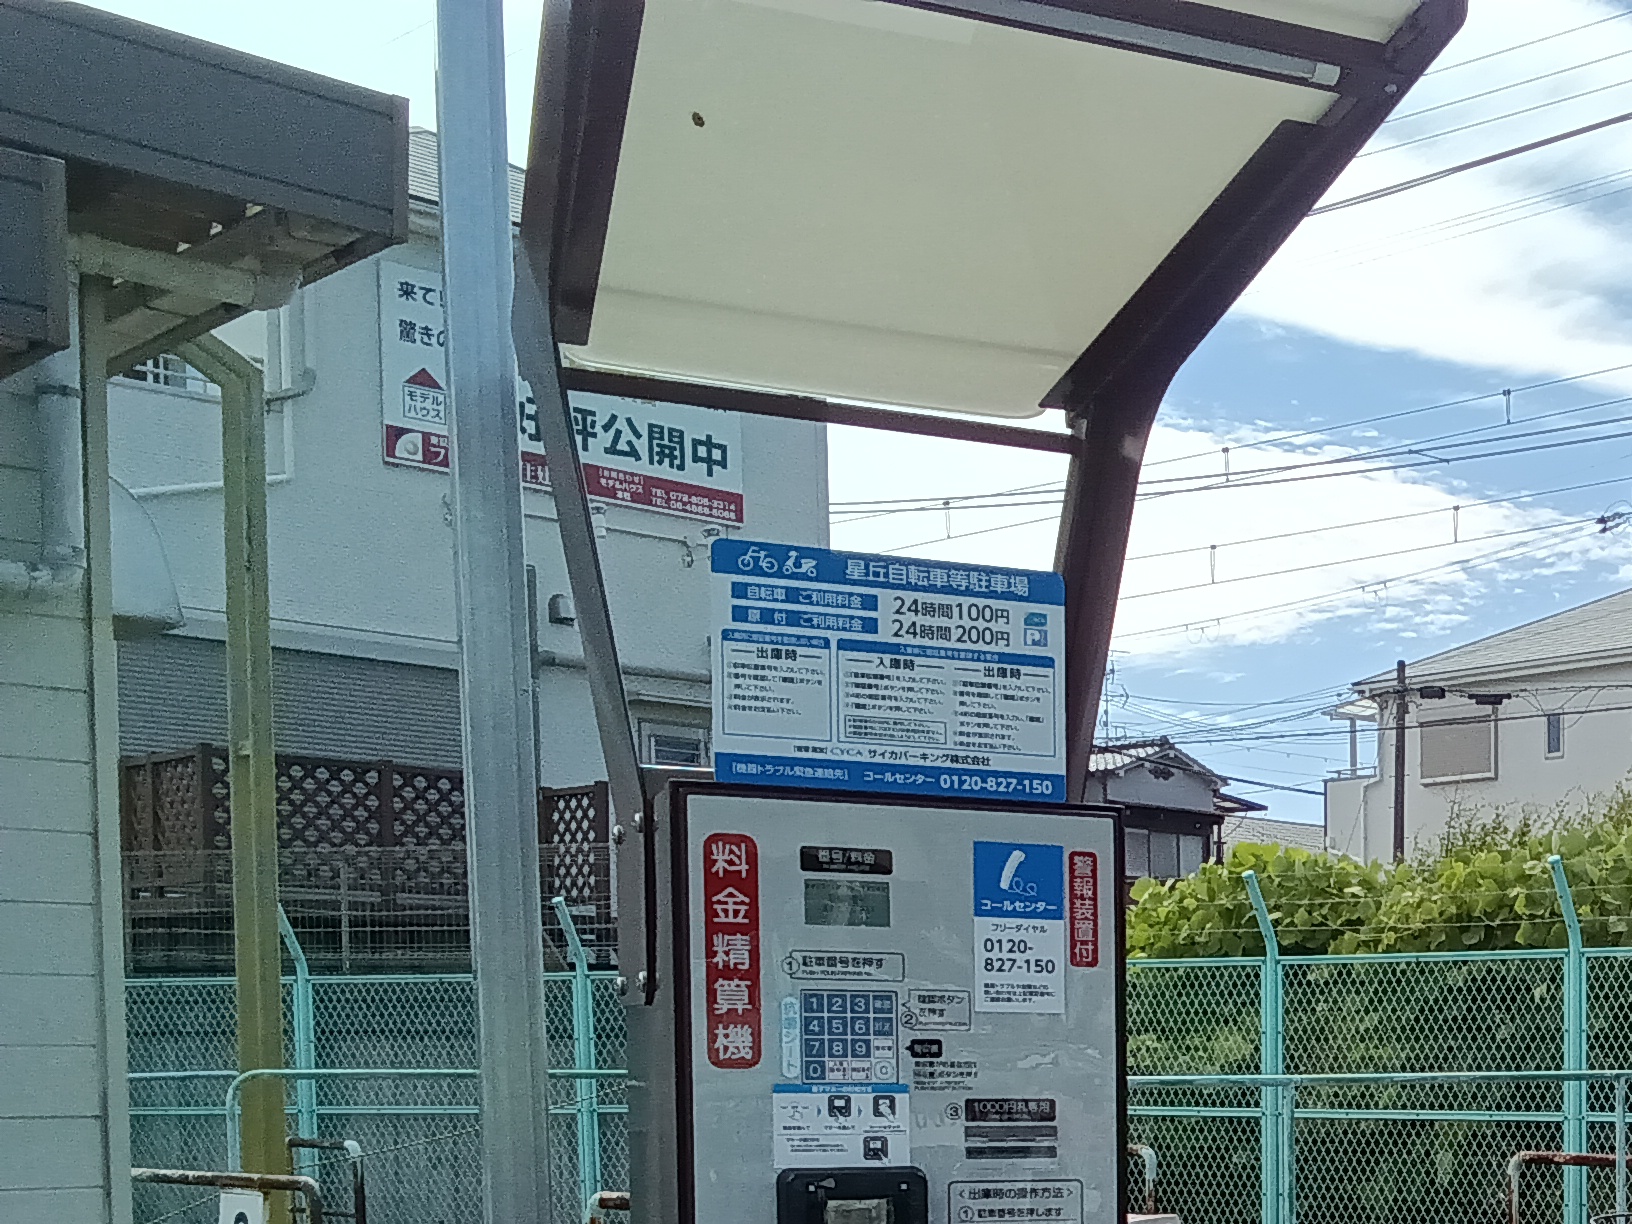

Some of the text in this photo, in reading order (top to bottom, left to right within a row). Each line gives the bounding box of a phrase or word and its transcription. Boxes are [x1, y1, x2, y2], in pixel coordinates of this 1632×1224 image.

[397, 281, 444, 308] 来て
[407, 390, 442, 406] モデル
[407, 404, 442, 420] ハウス
[845, 559, 1029, 597] 星丘自転車等駐車場
[747, 585, 862, 609] 自転車 ご利用料金
[892, 596, 1010, 625] 24時間100円
[800, 613, 864, 631] ご利用料金
[891, 619, 1011, 647] 24時間200円
[863, 771, 935, 785] コールセンター
[939, 774, 1053, 796] 0120-827-150
[980, 899, 1058, 912] コールセンター
[1073, 855, 1095, 962] 警報装置付
[990, 922, 1048, 934] フリーダイヤル
[710, 840, 753, 1061] 料金精算機
[983, 938, 1034, 954] 0120-
[983, 957, 1056, 974] 827-150
[809, 997, 818, 1011] 1
[831, 997, 842, 1011] 2
[854, 997, 866, 1012] 3
[808, 1019, 820, 1033] 4
[831, 1019, 843, 1033] 5
[854, 1019, 866, 1034] 6
[809, 1041, 820, 1055] 7
[832, 1041, 843, 1056] 8
[855, 1041, 866, 1056] 9
[809, 1063, 821, 1078] 0
[973, 1100, 1051, 1113] 1000円札専用
